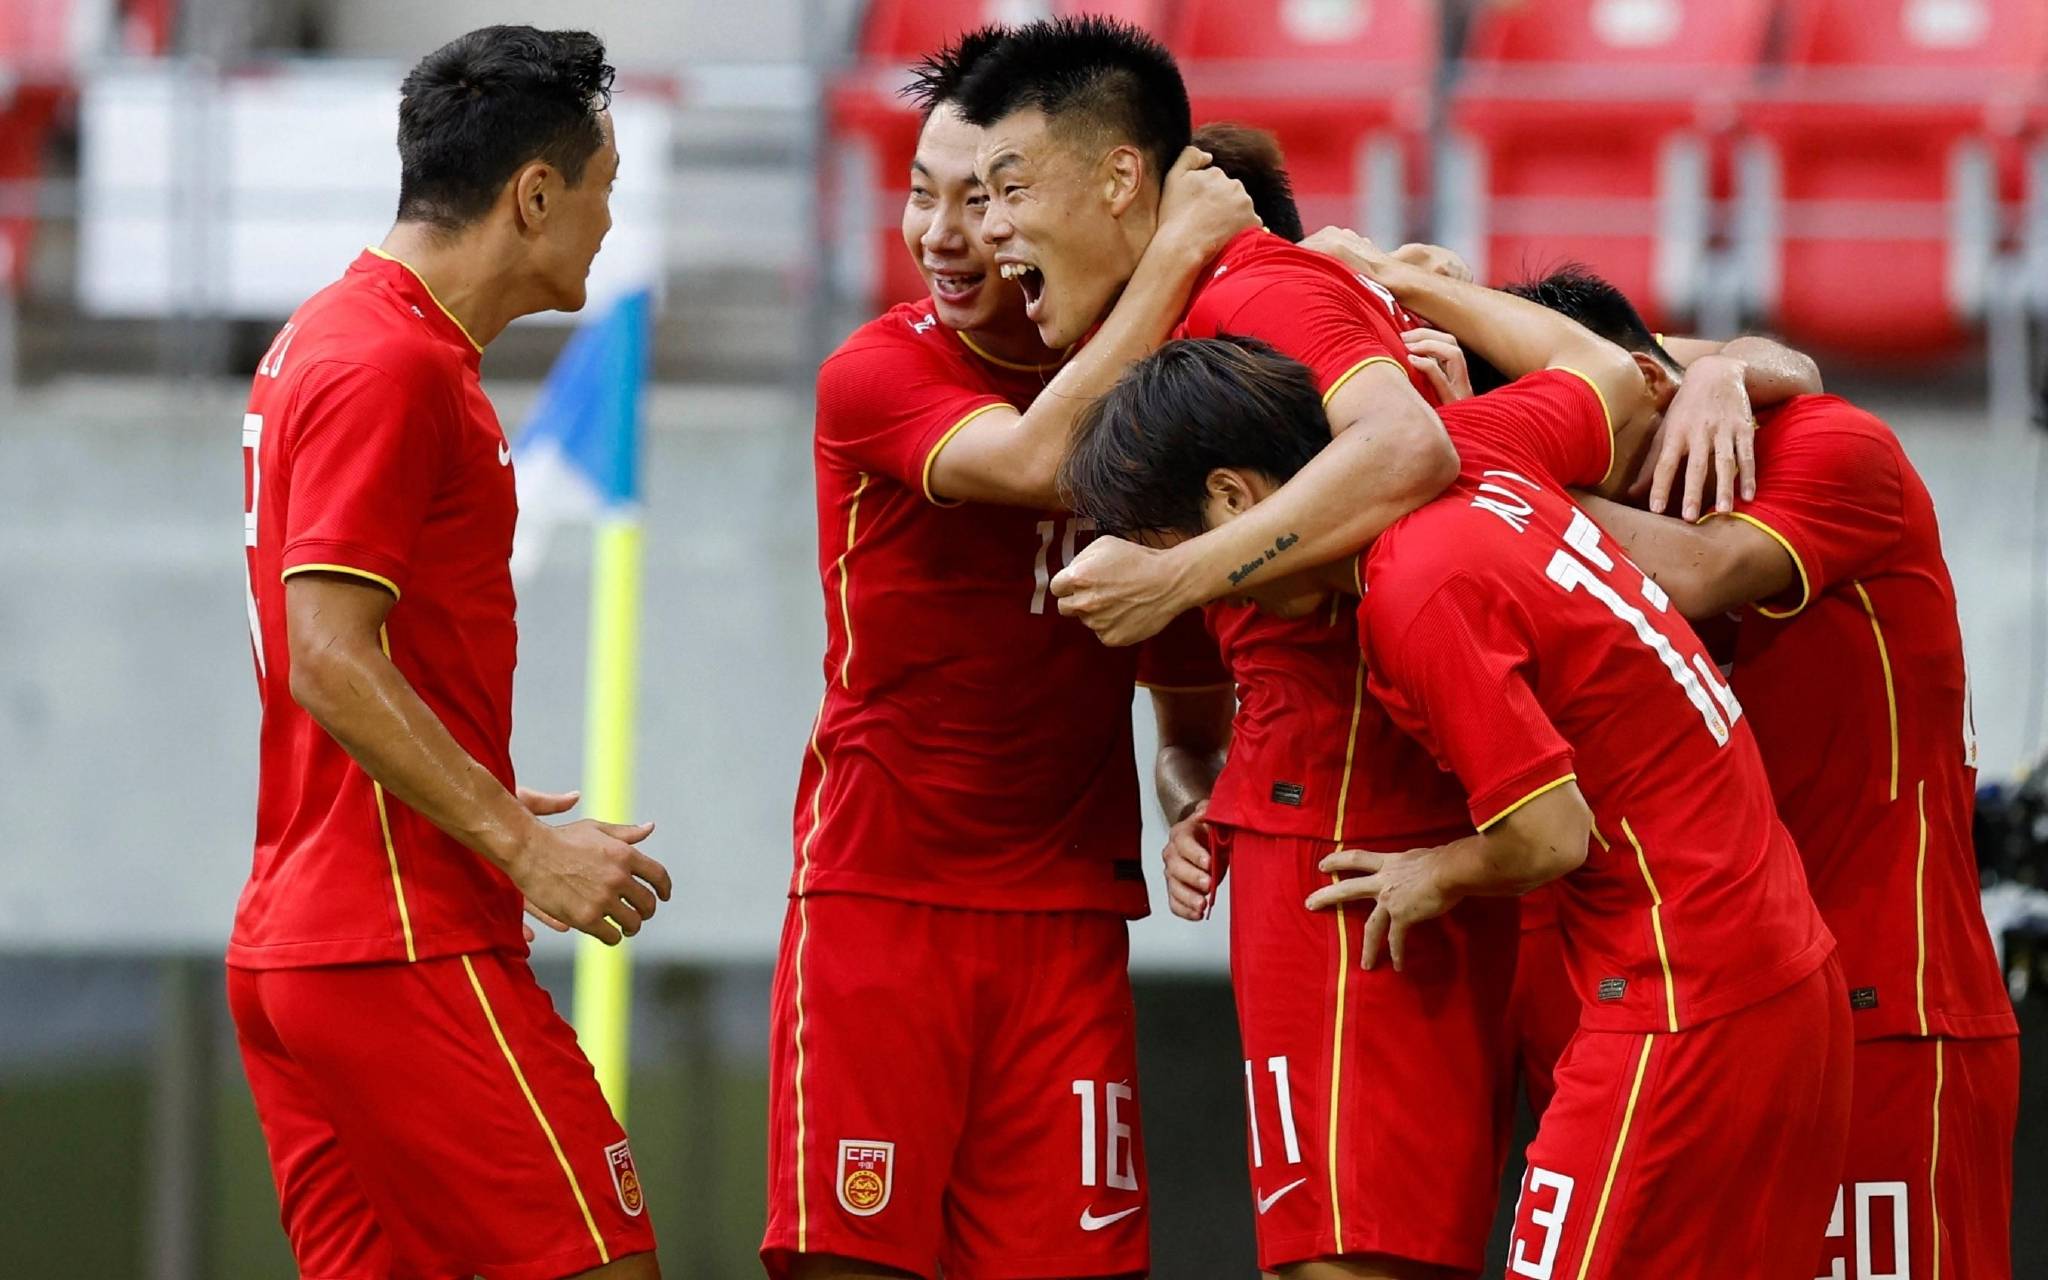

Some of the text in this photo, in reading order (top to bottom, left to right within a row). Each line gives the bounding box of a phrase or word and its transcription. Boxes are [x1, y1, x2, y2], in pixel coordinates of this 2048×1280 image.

[847, 1148, 886, 1162] CFA
[1072, 1079, 1139, 1191] 16
[1245, 1056, 1301, 1168] 11
